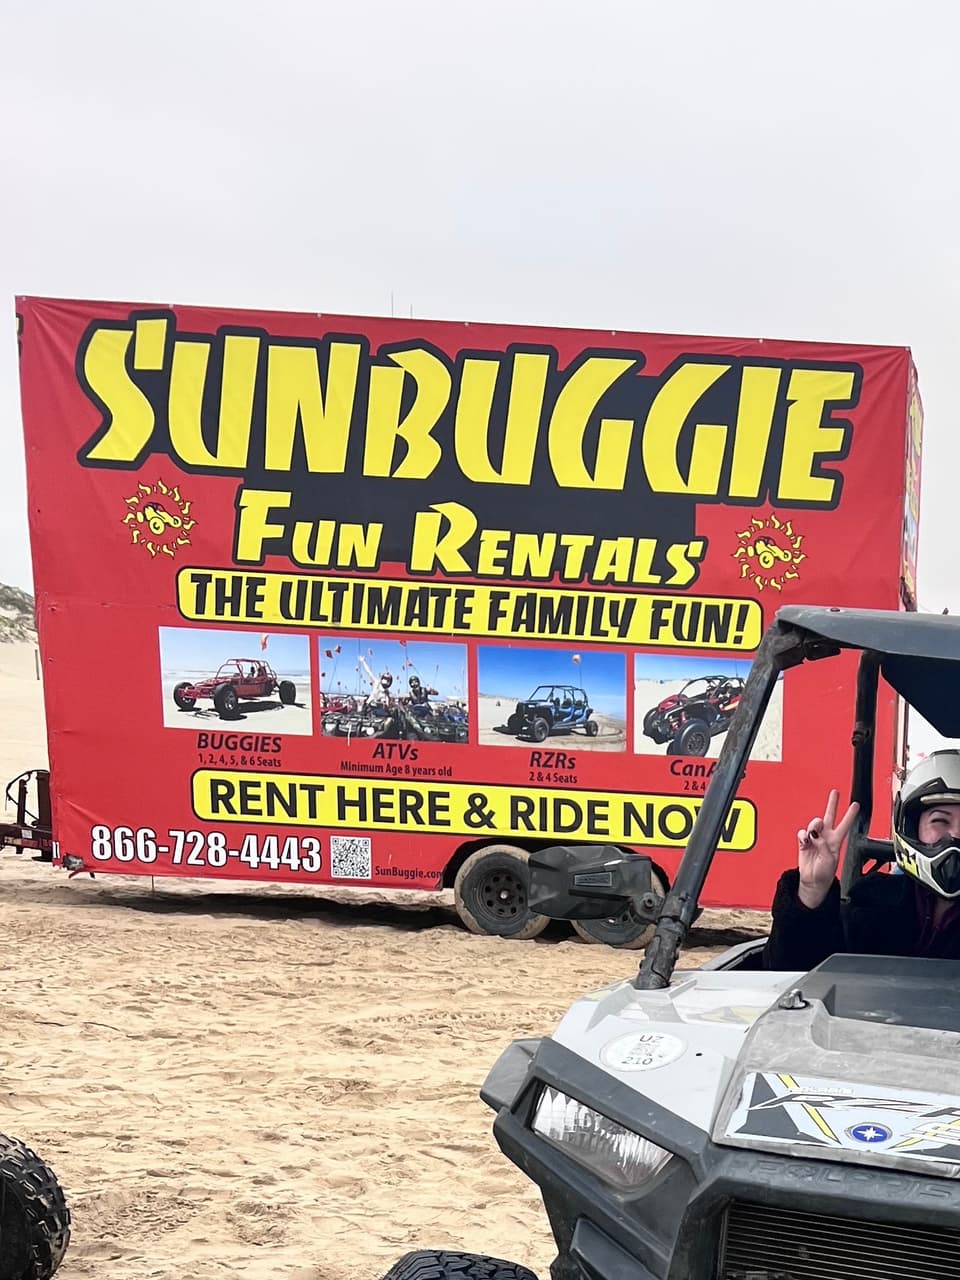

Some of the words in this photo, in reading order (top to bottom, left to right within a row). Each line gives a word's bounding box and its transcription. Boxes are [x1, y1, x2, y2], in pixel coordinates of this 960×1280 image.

[83, 317, 856, 502] SUNBUGGIE
[190, 573, 267, 618] THE
[278, 579, 475, 630] ULTIMATE
[487, 591, 638, 639] FAMILY
[648, 599, 750, 645] FUN!
[196, 732, 282, 753] BUGGIES
[372, 743, 419, 761] ATVs
[240, 756, 248, 765] &
[249, 756, 256, 766] 6
[257, 756, 282, 767] Seats
[340, 761, 384, 773] Minimum
[386, 763, 403, 776] Age
[404, 765, 411, 775] 8
[412, 766, 436, 777] years
[437, 766, 453, 777] old
[529, 751, 577, 770] RZRs
[529, 771, 536, 781] 2
[537, 771, 544, 782] &
[545, 773, 552, 783] 4
[553, 772, 578, 784] Seats
[684, 780, 690, 791] 2
[691, 781, 699, 791] &
[209, 778, 325, 819] RENT
[336, 785, 451, 827] HERE
[463, 792, 497, 830] &
[510, 795, 610, 836] RIDE
[90, 824, 323, 873] 866-728-4443
